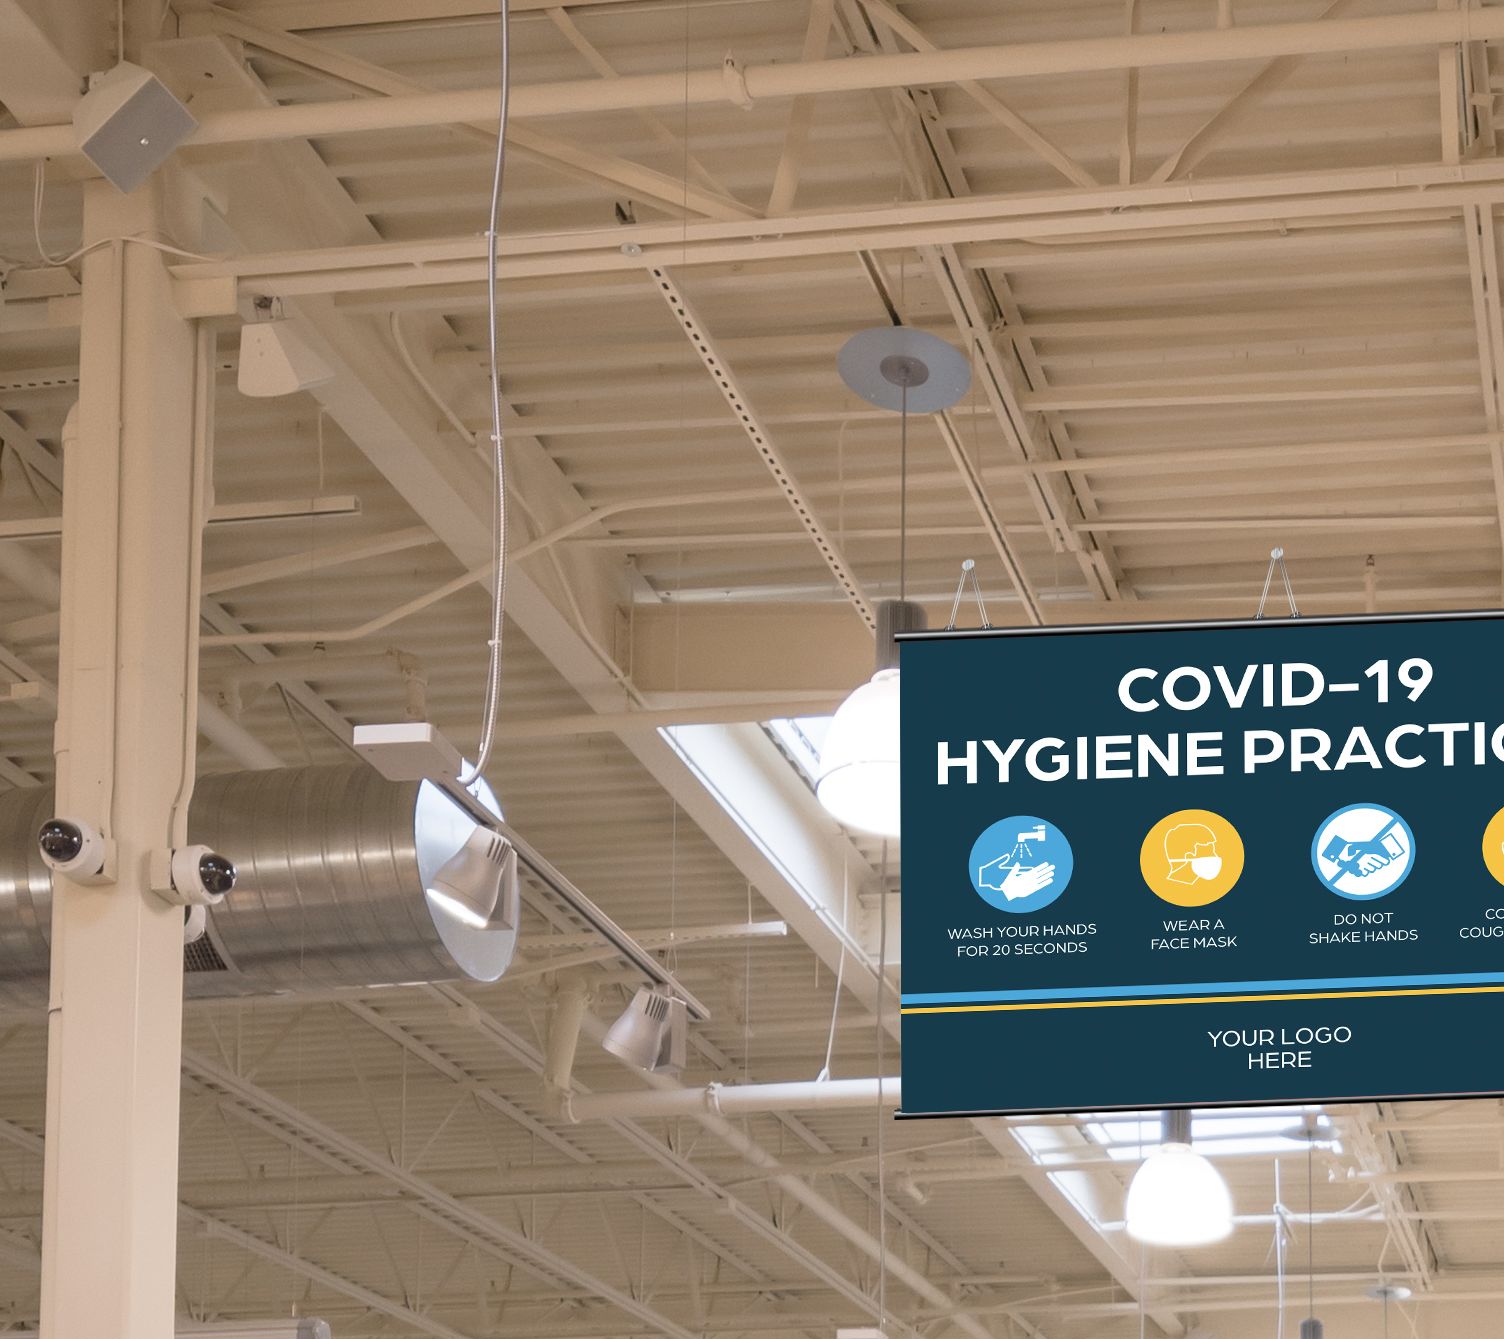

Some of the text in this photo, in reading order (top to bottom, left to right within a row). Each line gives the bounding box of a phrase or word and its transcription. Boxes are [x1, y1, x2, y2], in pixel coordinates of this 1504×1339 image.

[1118, 658, 1433, 712] COVID-19
[938, 732, 1224, 785] HYGIENE
[1162, 918, 1225, 932] WEAR A
[1334, 912, 1394, 926] DO NOT
[947, 923, 1097, 940] WASH YOUR HANDS
[1309, 929, 1419, 944] SHAKE HANDS
[957, 941, 1088, 958] FOR 20 SECONDS
[1151, 935, 1238, 950] FACE MASK
[1207, 1026, 1352, 1048] YOUR LOGO
[1248, 1050, 1312, 1070] HERE
